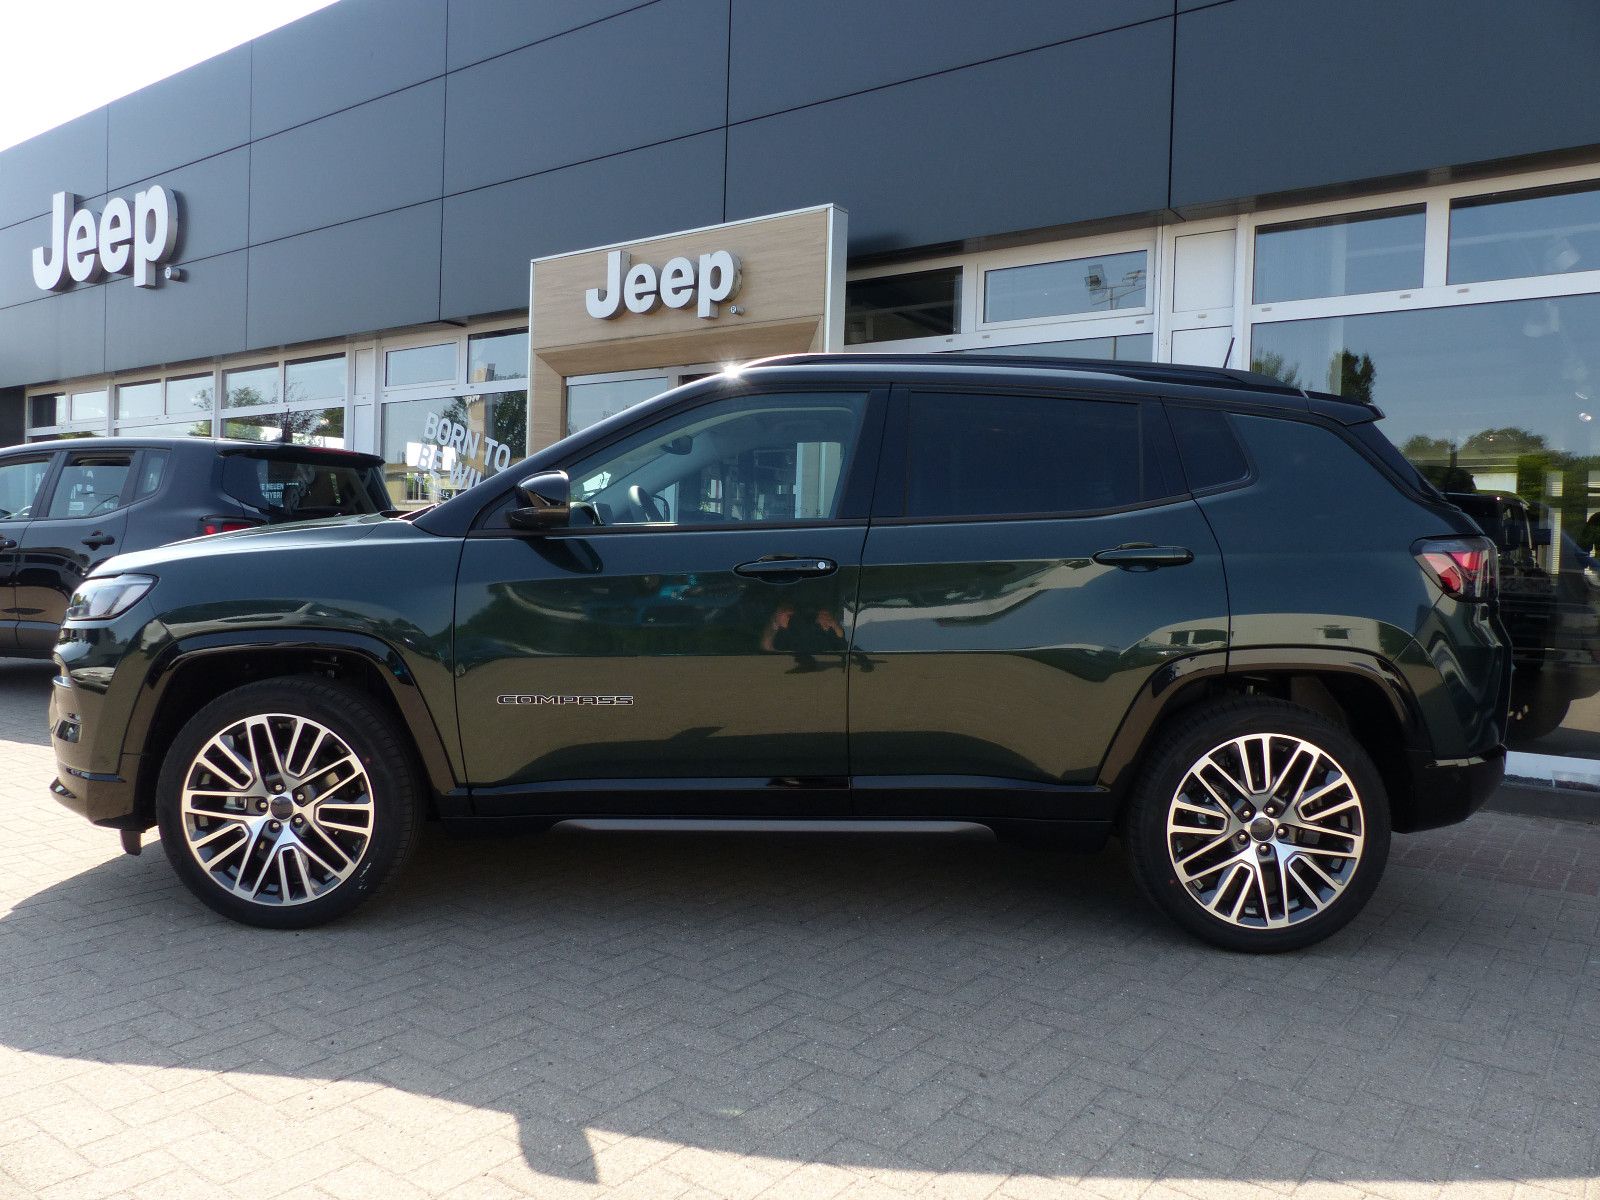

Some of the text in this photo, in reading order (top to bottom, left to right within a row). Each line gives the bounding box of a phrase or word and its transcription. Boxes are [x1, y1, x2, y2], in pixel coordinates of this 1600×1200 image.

[32, 185, 174, 291] Jeep
[586, 250, 738, 319] Jeep
[417, 443, 443, 478] BE
[424, 411, 511, 473] BORN TO
[497, 694, 634, 706] COMPASS
